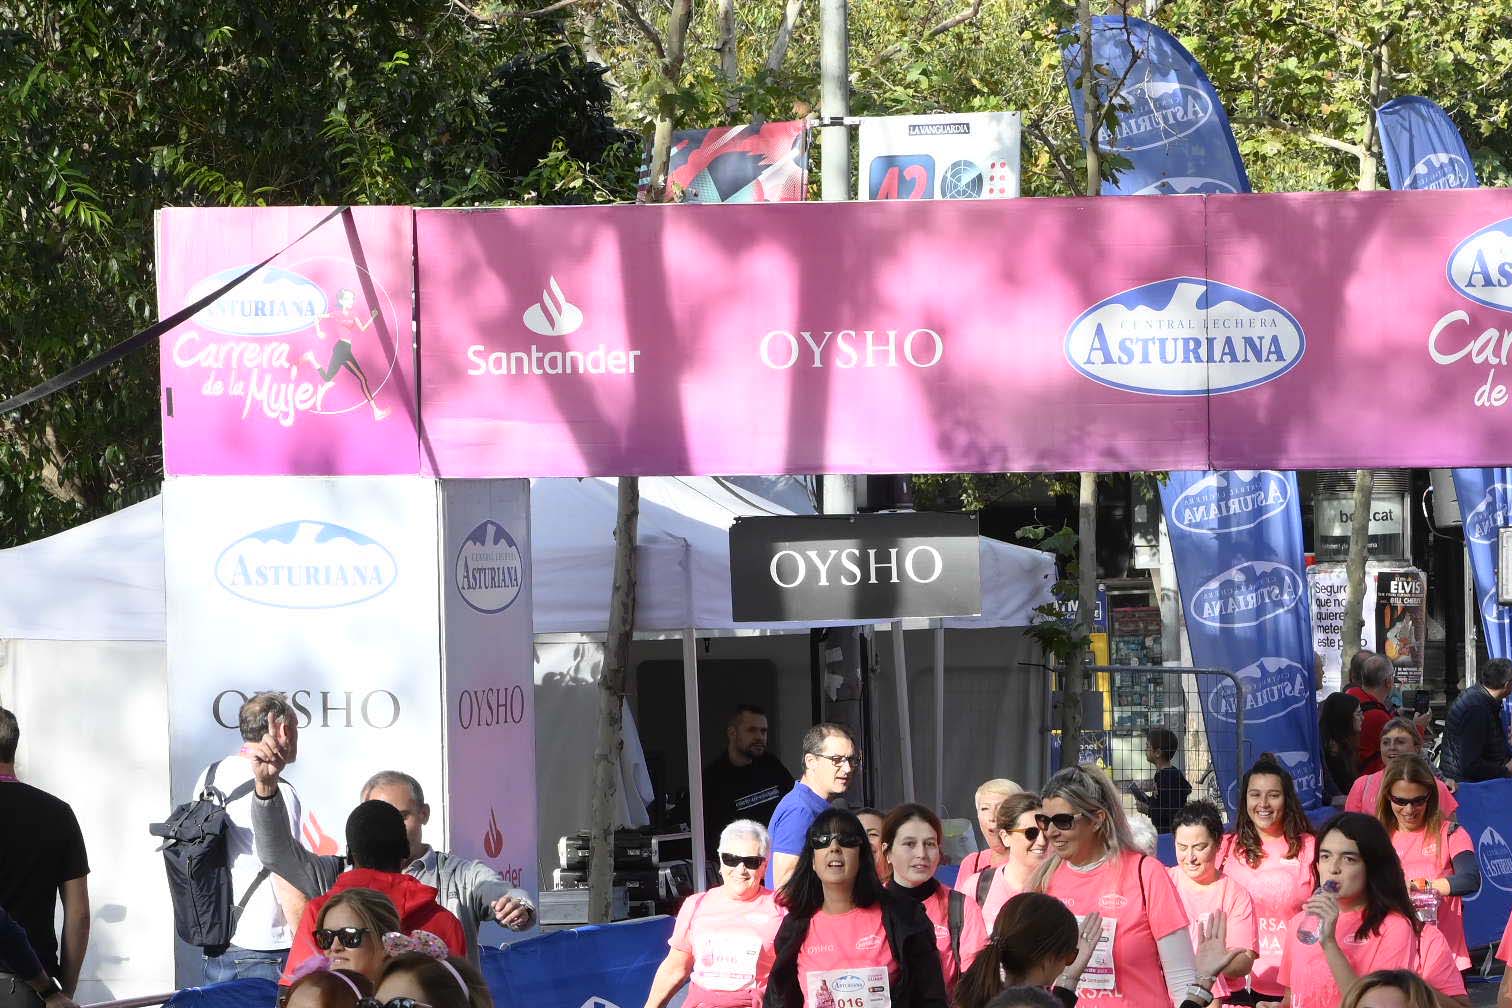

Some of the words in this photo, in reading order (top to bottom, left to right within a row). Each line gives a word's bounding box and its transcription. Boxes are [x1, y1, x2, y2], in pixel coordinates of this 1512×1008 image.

[1202, 318, 1278, 329] LECHERA
[173, 330, 290, 368] Carrera
[467, 344, 641, 376] Santander
[759, 328, 944, 370] OYSHO
[1083, 321, 1287, 366] ASTURIANA
[201, 370, 224, 396] de
[228, 368, 244, 396] la
[242, 364, 335, 427] Mujer
[1474, 368, 1508, 407] de
[231, 554, 383, 587] ASTURIANA
[460, 555, 519, 591] ASTURIANA
[769, 545, 943, 588] OYSHO
[1316, 597, 1332, 609] que
[1390, 581, 1421, 594] ELVIS
[212, 688, 402, 730] OSHO
[458, 684, 525, 730] OYSHO
[837, 998, 864, 1008] 016
